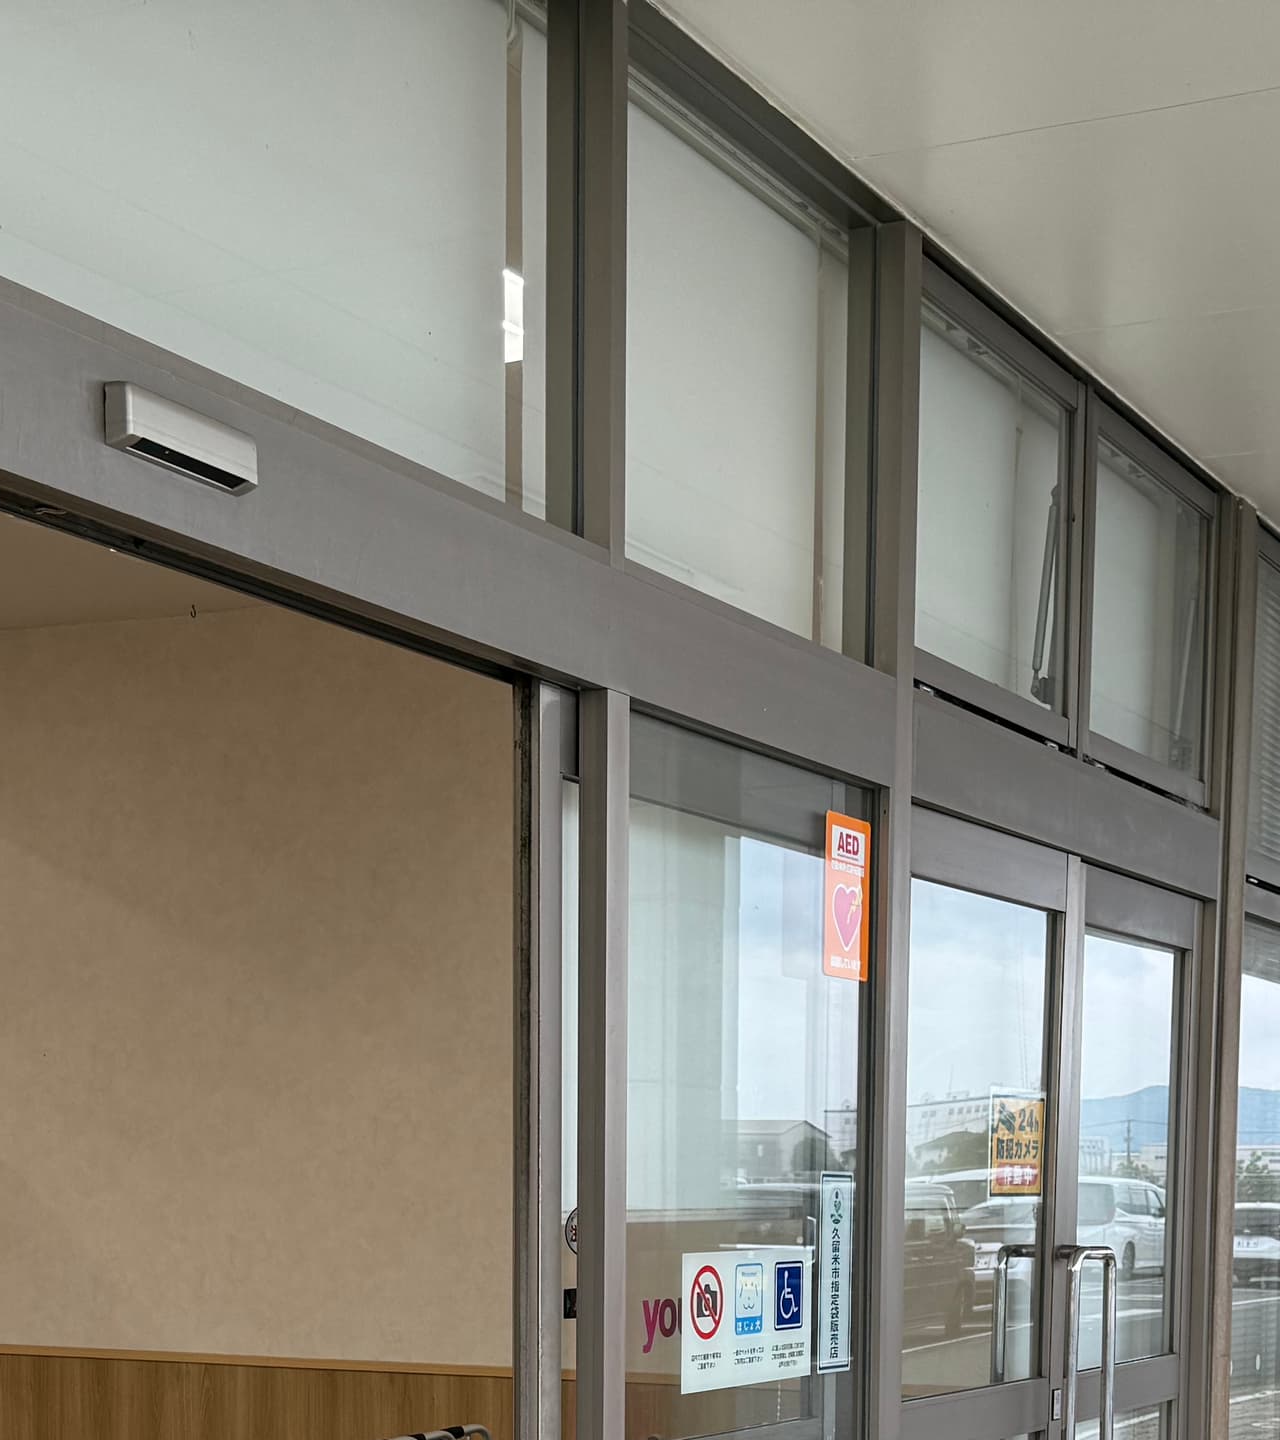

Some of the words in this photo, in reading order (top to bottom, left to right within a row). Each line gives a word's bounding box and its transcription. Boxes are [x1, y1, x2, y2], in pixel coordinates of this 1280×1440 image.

[837, 831, 860, 856] AED
[1018, 1107, 1039, 1133] 24h
[996, 1138, 1039, 1160] 防犯カメラ
[642, 1297, 682, 1354] yo
